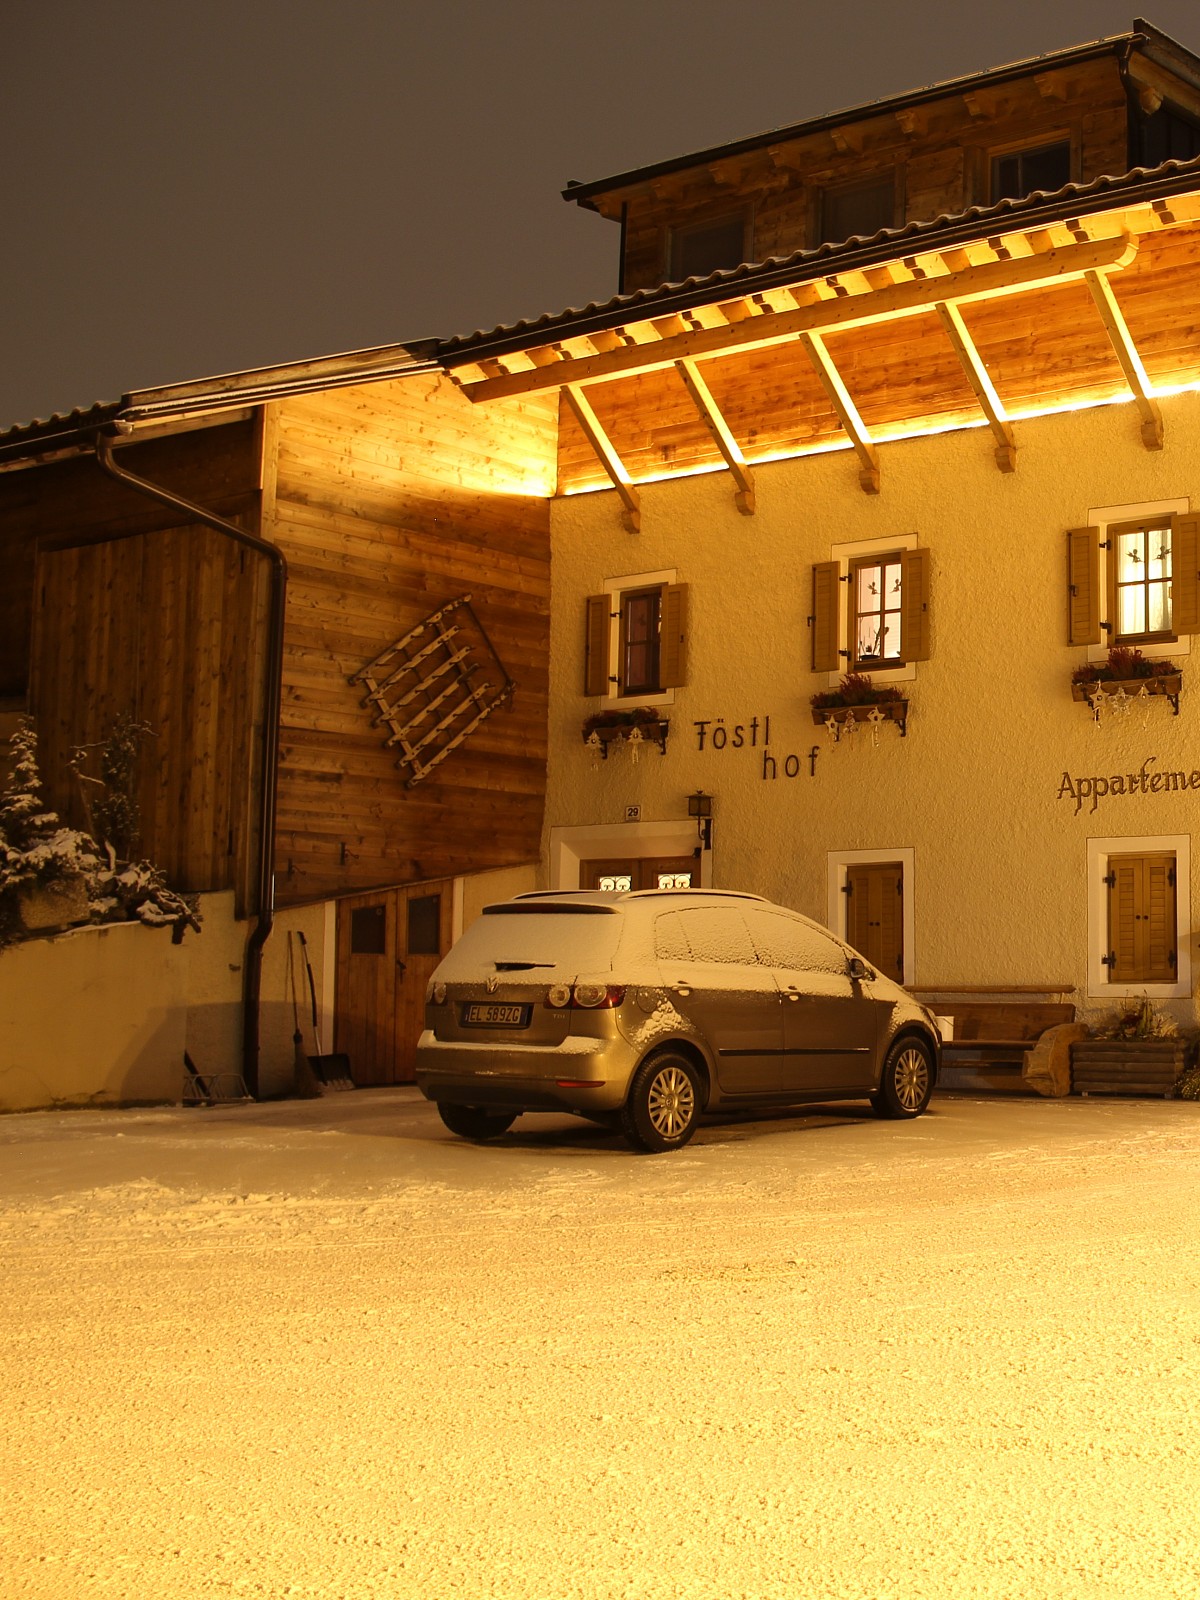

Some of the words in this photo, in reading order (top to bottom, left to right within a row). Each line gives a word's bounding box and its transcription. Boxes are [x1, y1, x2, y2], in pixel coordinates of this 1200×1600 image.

[762, 745, 820, 780] hof
[627, 807, 639, 817] 29
[470, 1006, 482, 1021] EL
